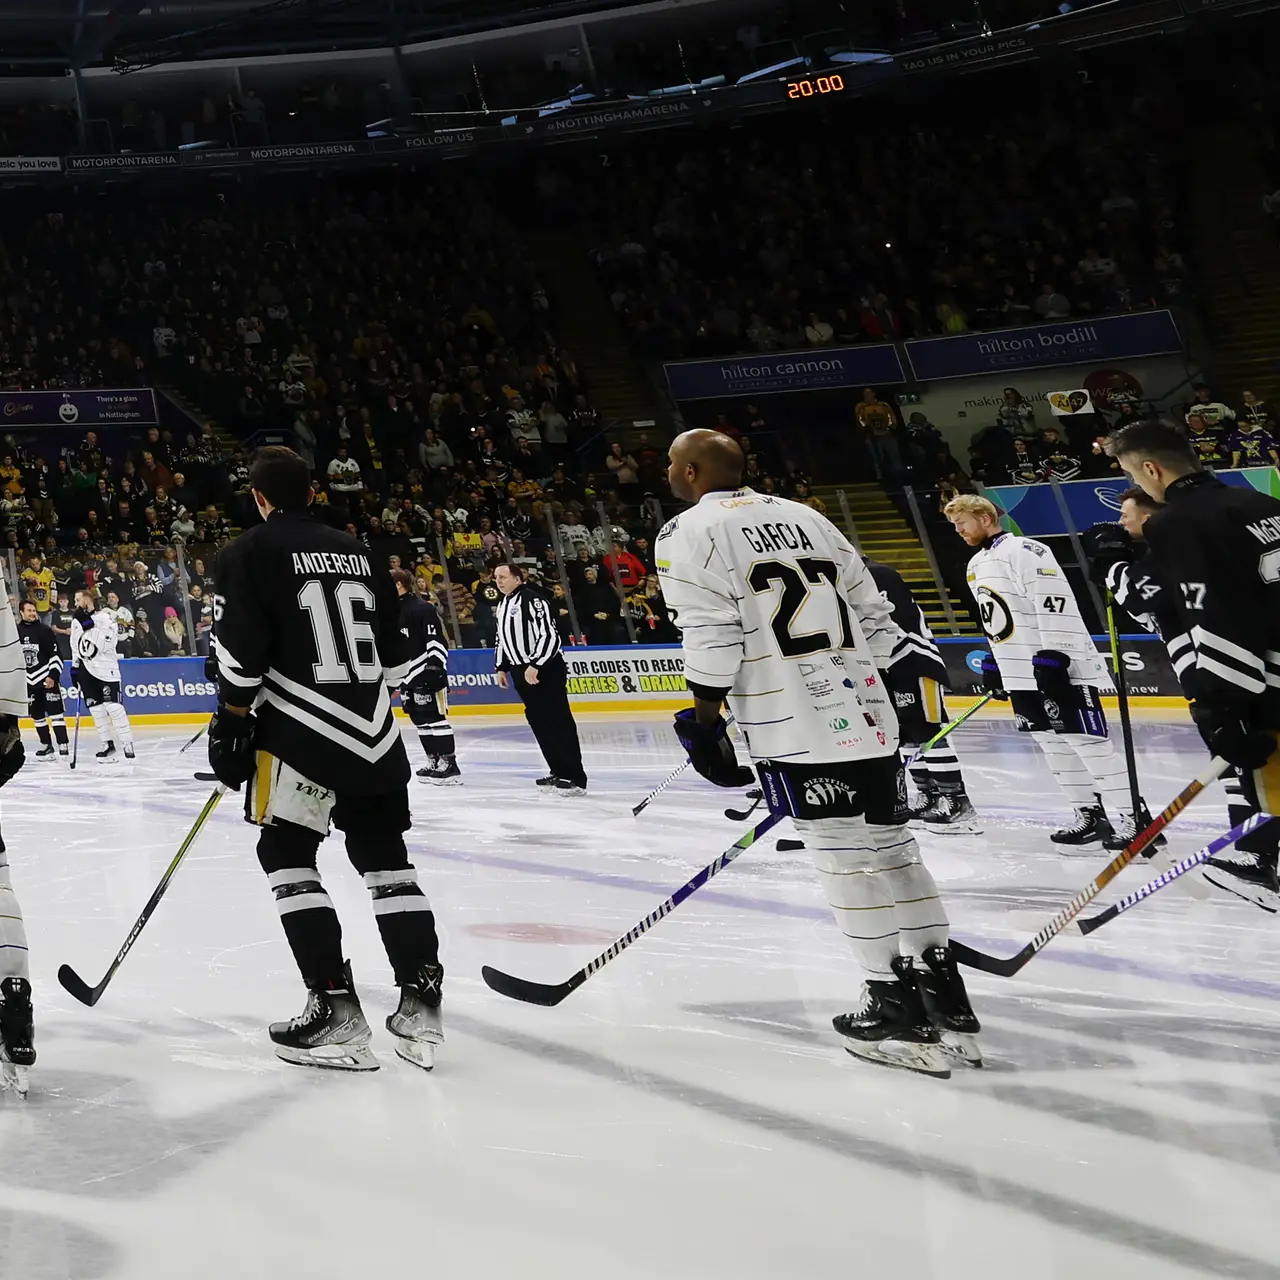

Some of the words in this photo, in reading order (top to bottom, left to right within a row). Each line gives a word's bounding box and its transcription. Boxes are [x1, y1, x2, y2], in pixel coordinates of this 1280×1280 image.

[903, 59, 924, 71] TAG
[927, 56, 943, 66] US
[946, 52, 959, 62] IN
[961, 45, 995, 60] YOUR
[998, 38, 1026, 50] PICS
[788, 74, 843, 99] 20:00
[406, 135, 453, 147] FOLLOW
[456, 132, 474, 142] US
[72, 155, 176, 167] MOTORPOINTARENA
[251, 144, 355, 159] MOTORPOINTARENA
[18, 160, 36, 170] you
[37, 158, 57, 168] love
[977, 337, 1034, 355] hilton
[1038, 327, 1097, 347] bodill
[721, 363, 773, 380] hilton
[776, 358, 843, 375] cannon
[123, 395, 138, 403] glass
[105, 411, 140, 419] Nottingham
[742, 523, 814, 554] GARCIA
[292, 552, 372, 577] ANDERSON
[1135, 575, 1162, 600] 14
[745, 556, 857, 660] 27
[1043, 596, 1066, 613] 47
[297, 579, 379, 684] 16
[572, 661, 588, 675] QR
[590, 660, 631, 673] CODES
[633, 659, 649, 673] TO
[652, 658, 685, 672] REAC
[124, 681, 176, 697] costs
[178, 679, 216, 696] less
[622, 676, 637, 693] &
[641, 674, 688, 692] DRAW
[803, 778, 850, 790] DIZZYFISH
[1116, 846, 1211, 913] WARRIOR
[1032, 880, 1099, 952] WARRIOR
[583, 896, 676, 979] WARRIOR
[308, 1026, 331, 1043] BAUER
